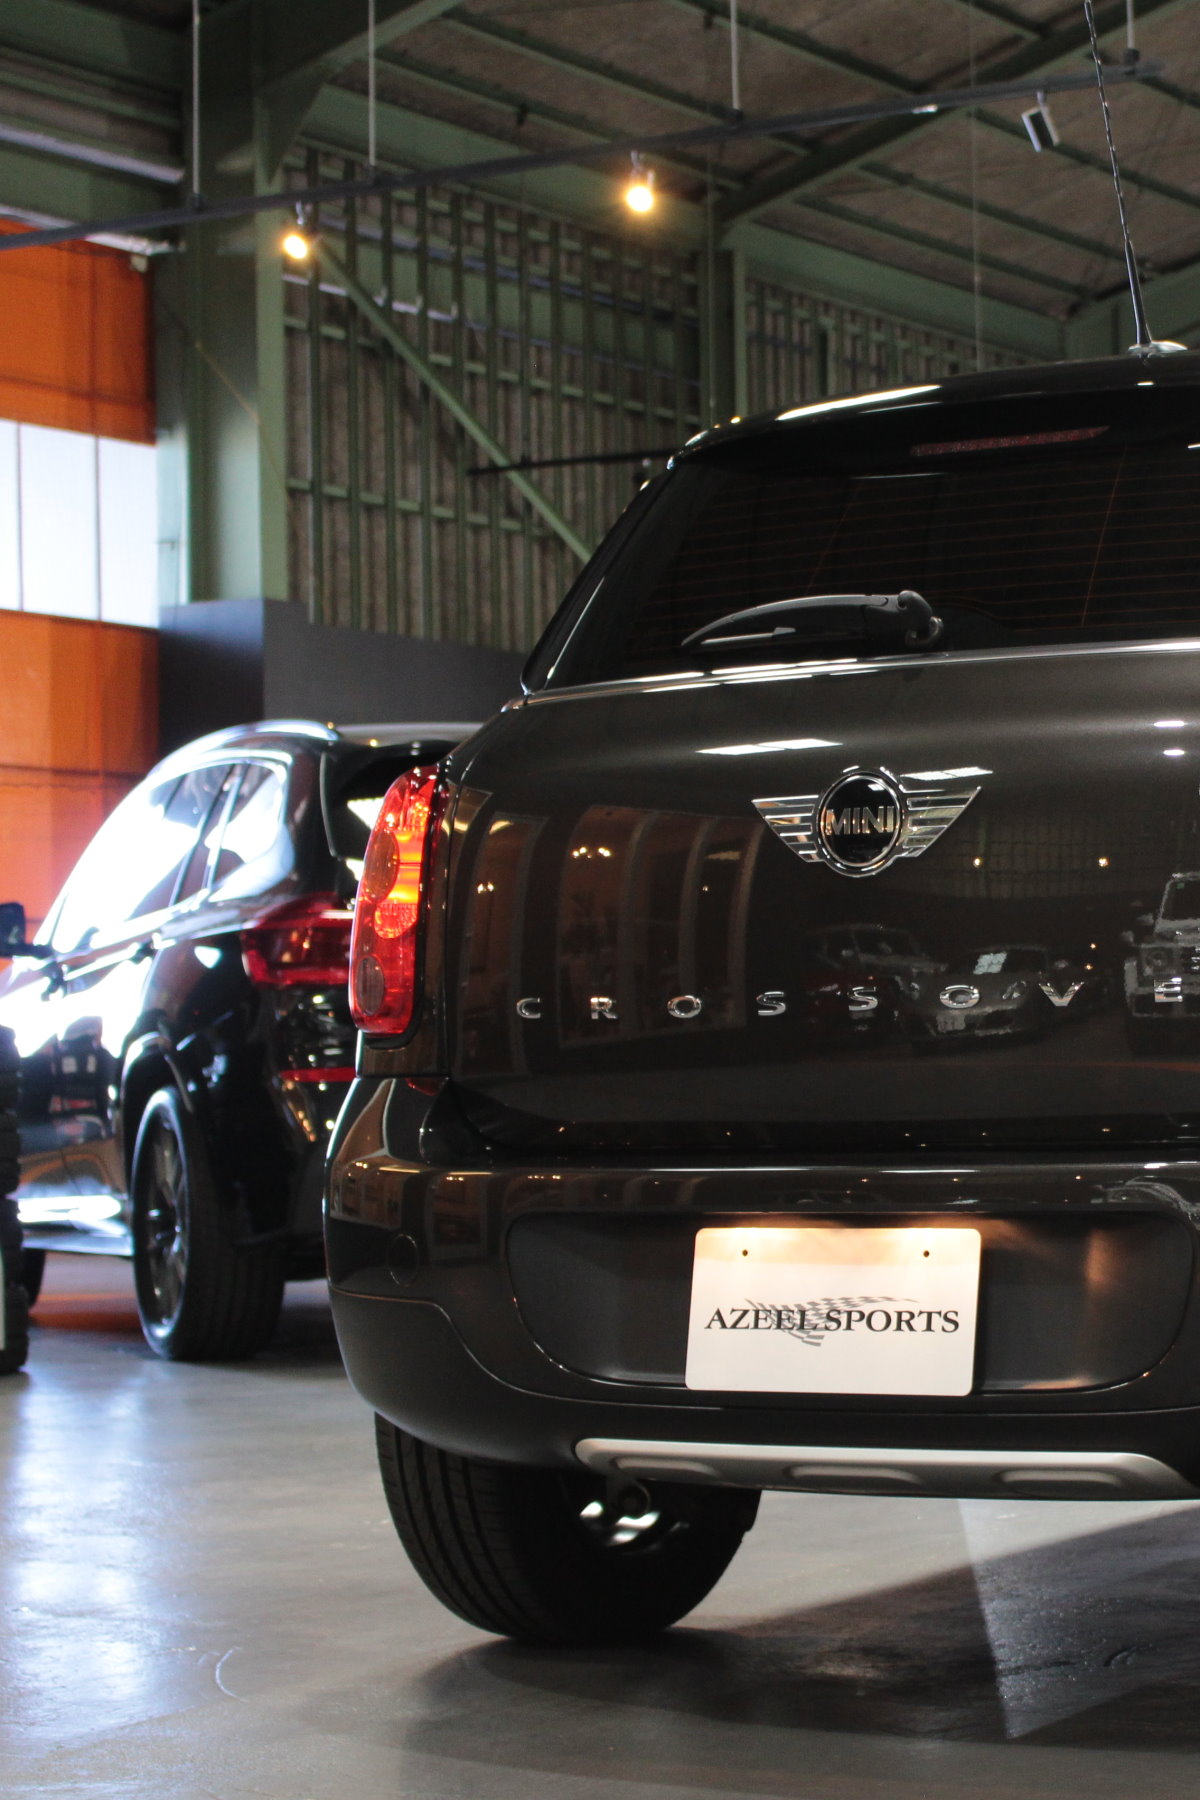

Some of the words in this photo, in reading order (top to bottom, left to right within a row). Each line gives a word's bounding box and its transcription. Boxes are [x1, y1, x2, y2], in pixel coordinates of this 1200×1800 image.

[825, 805, 895, 836] MINI
[704, 1308, 817, 1331] AZEEL
[825, 1309, 960, 1333] SPORTS
